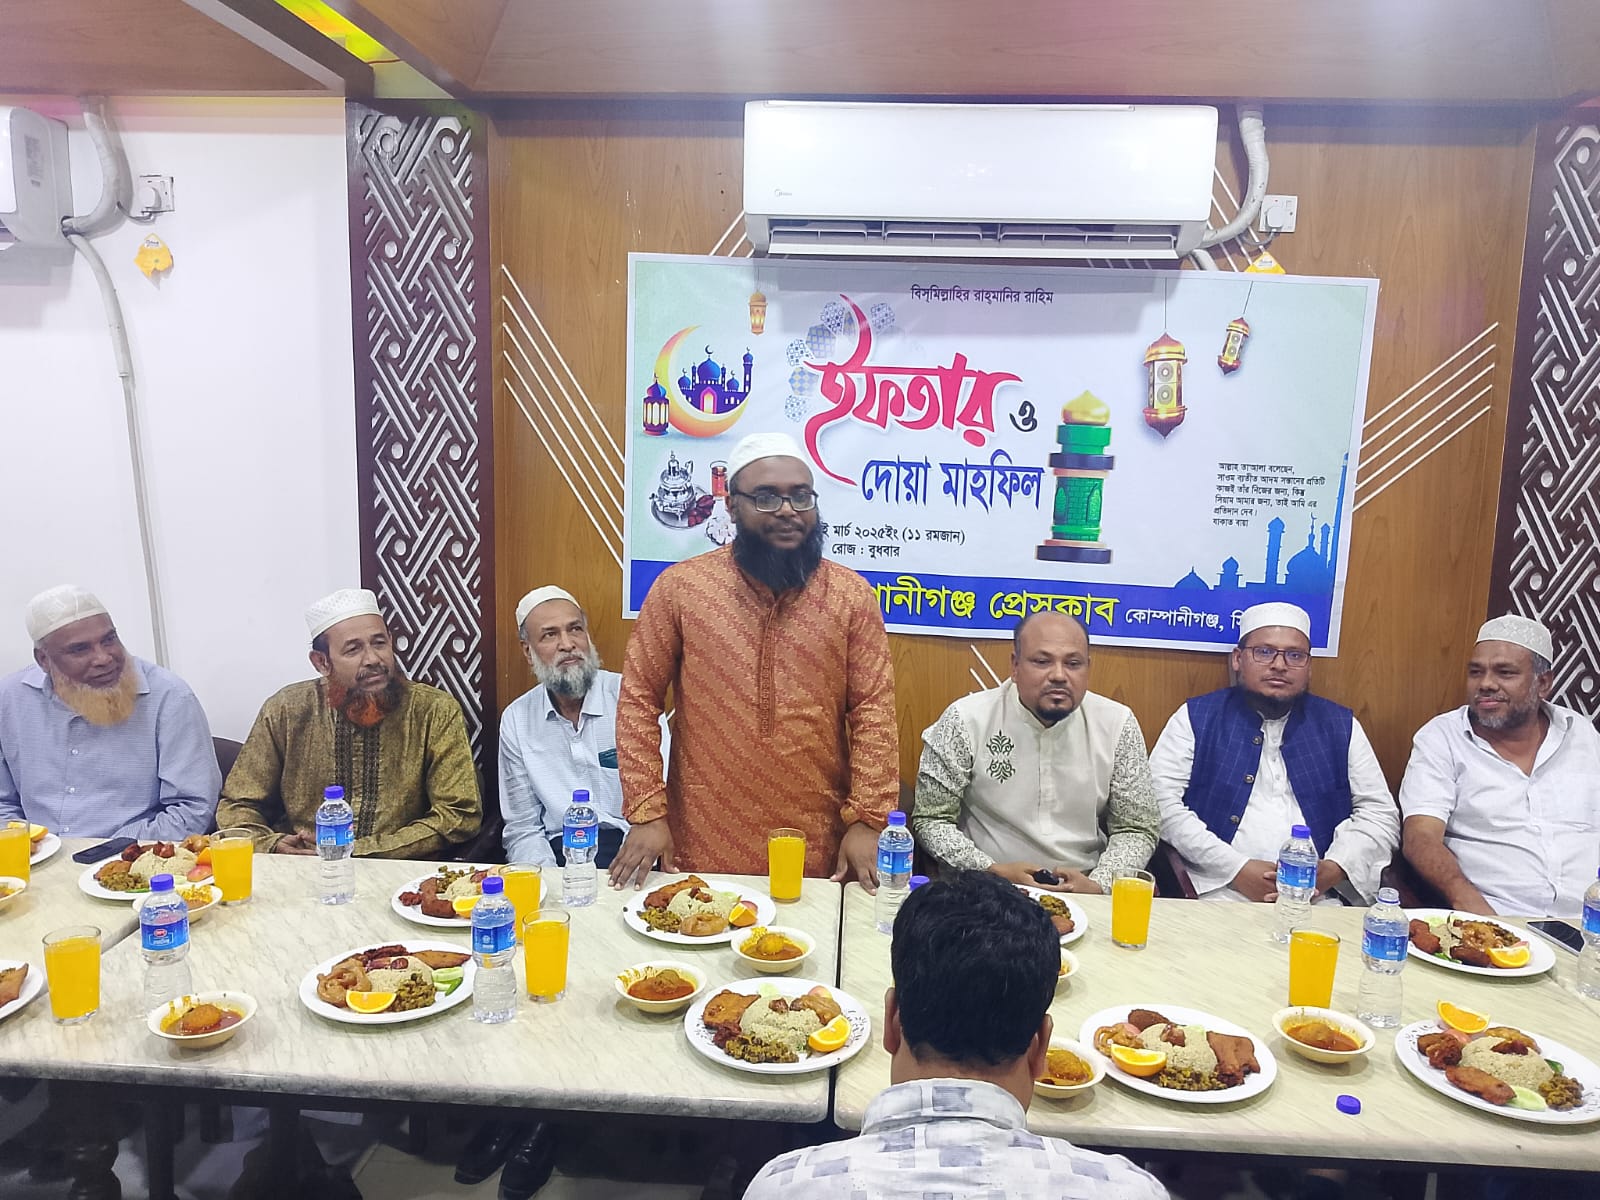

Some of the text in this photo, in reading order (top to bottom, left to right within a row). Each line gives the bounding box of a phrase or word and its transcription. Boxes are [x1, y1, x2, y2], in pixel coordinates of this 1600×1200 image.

[1024, 288, 1054, 305] রাহিম
[803, 294, 1038, 487] ইফতার ও
[862, 449, 1045, 514] দোয়া মাহফিল
[833, 522, 852, 537] মার্চ
[902, 527, 921, 543] (১১
[925, 529, 965, 546] রমজান)
[832, 543, 856, 555] রোজ
[868, 544, 900, 559] বুধবার
